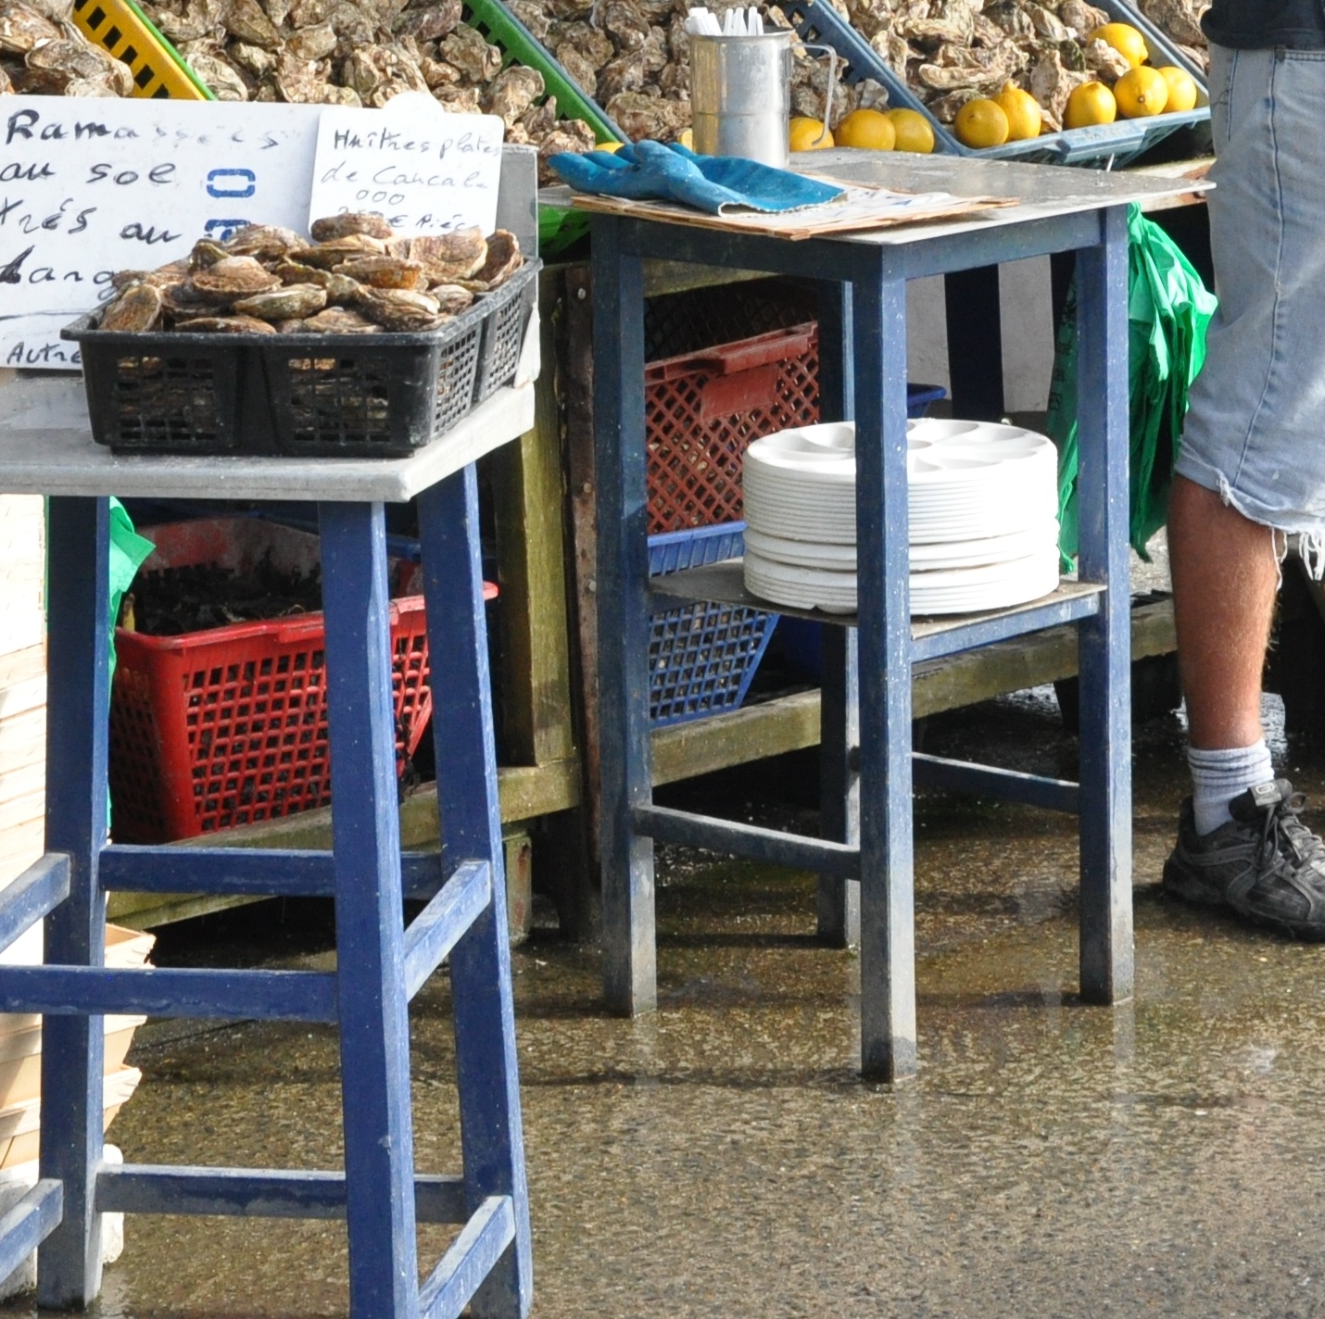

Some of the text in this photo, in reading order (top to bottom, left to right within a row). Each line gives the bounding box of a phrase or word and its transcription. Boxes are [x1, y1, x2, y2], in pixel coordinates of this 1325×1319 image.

[334, 127, 501, 160] Huîtres plates
[0, 161, 177, 186] au sol
[321, 161, 489, 189] de Cancale
[119, 222, 183, 245] au
